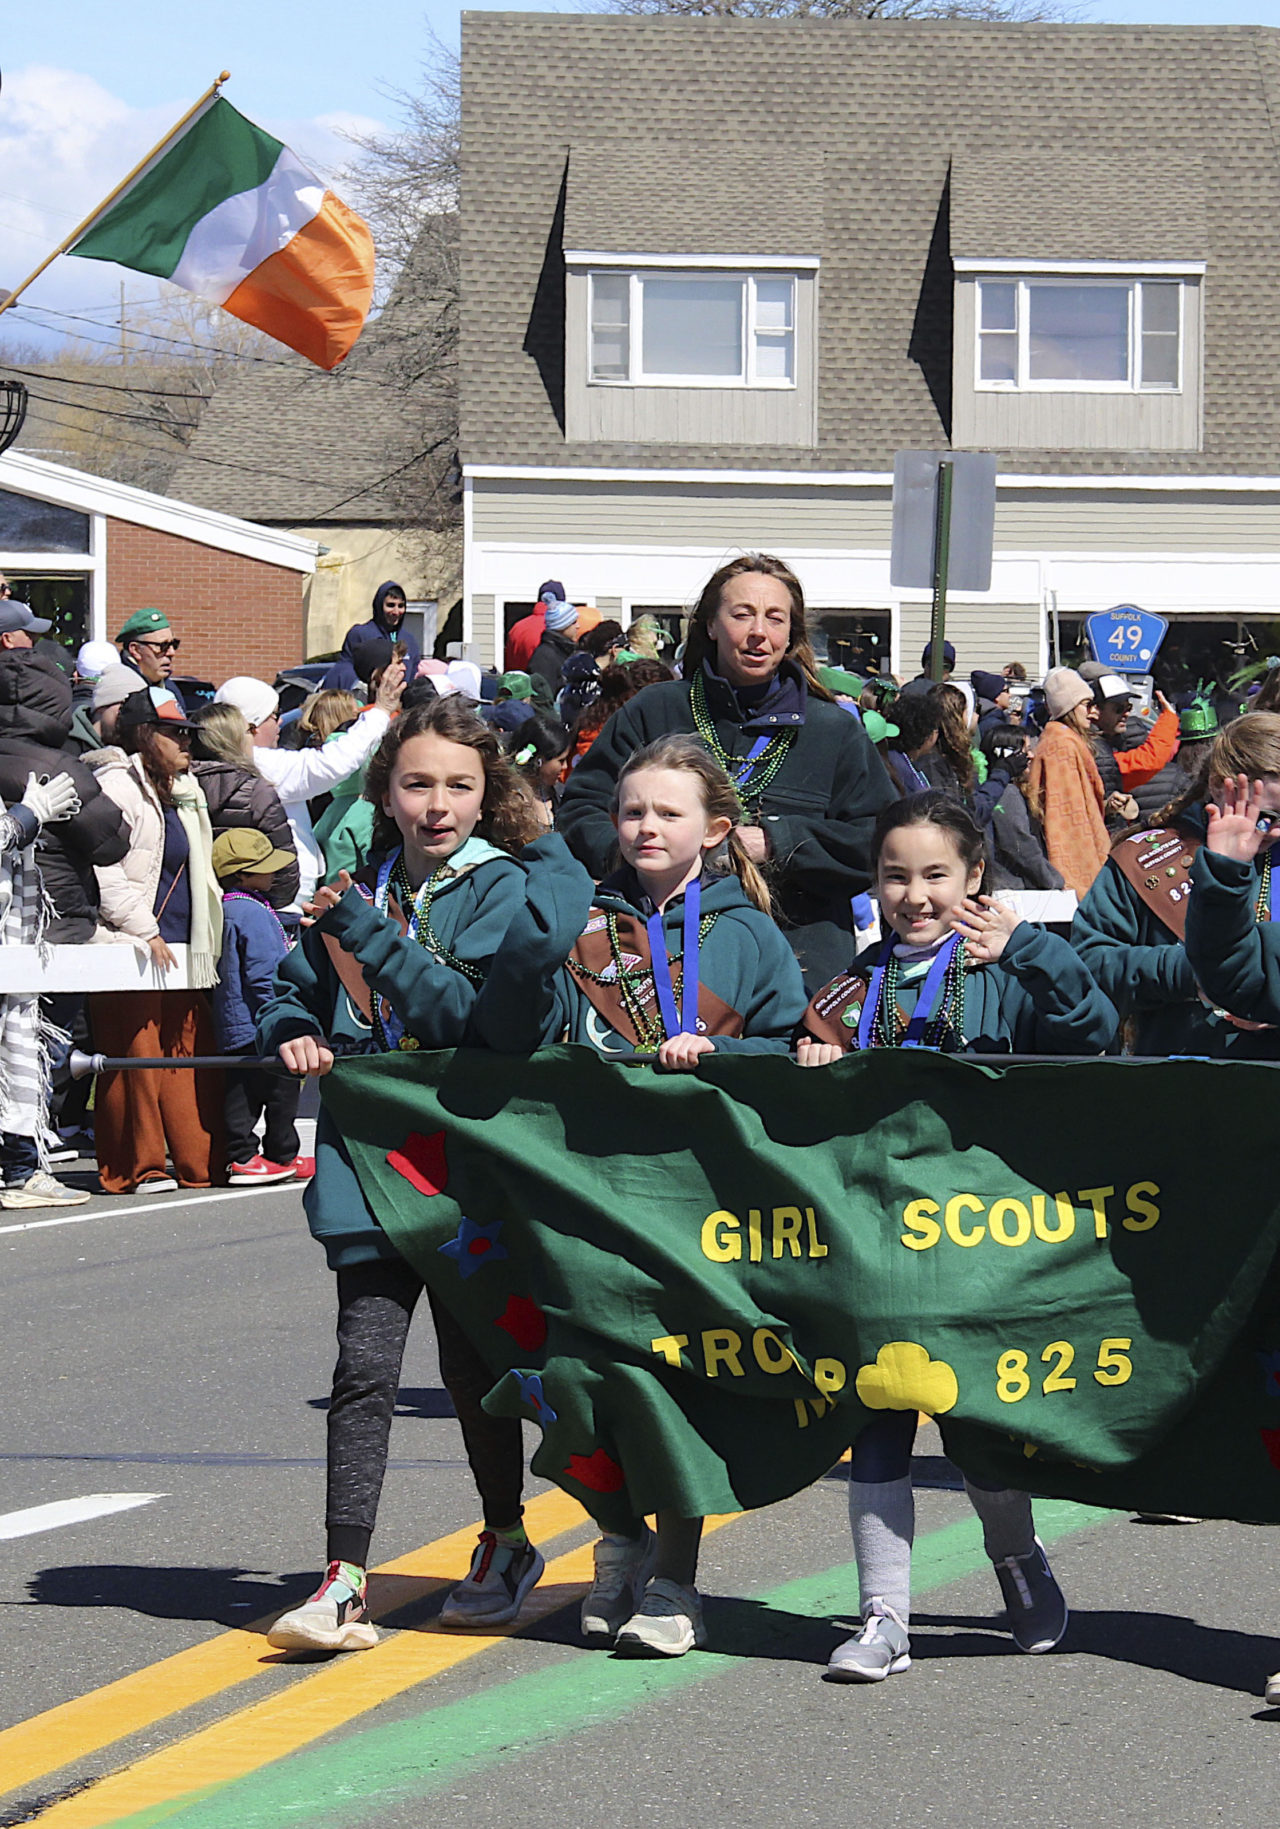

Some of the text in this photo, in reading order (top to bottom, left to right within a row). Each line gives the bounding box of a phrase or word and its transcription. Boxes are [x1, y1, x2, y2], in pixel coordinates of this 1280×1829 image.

[1110, 612, 1142, 622] SUFFOLK
[1107, 625, 1143, 650] 49
[1109, 653, 1138, 662] COUNTY
[1169, 879, 1194, 902] 82
[841, 982, 861, 999] COUNTY
[701, 1181, 1160, 1263] GIRL SCOUTS
[652, 1328, 1133, 1410] TROP 825
